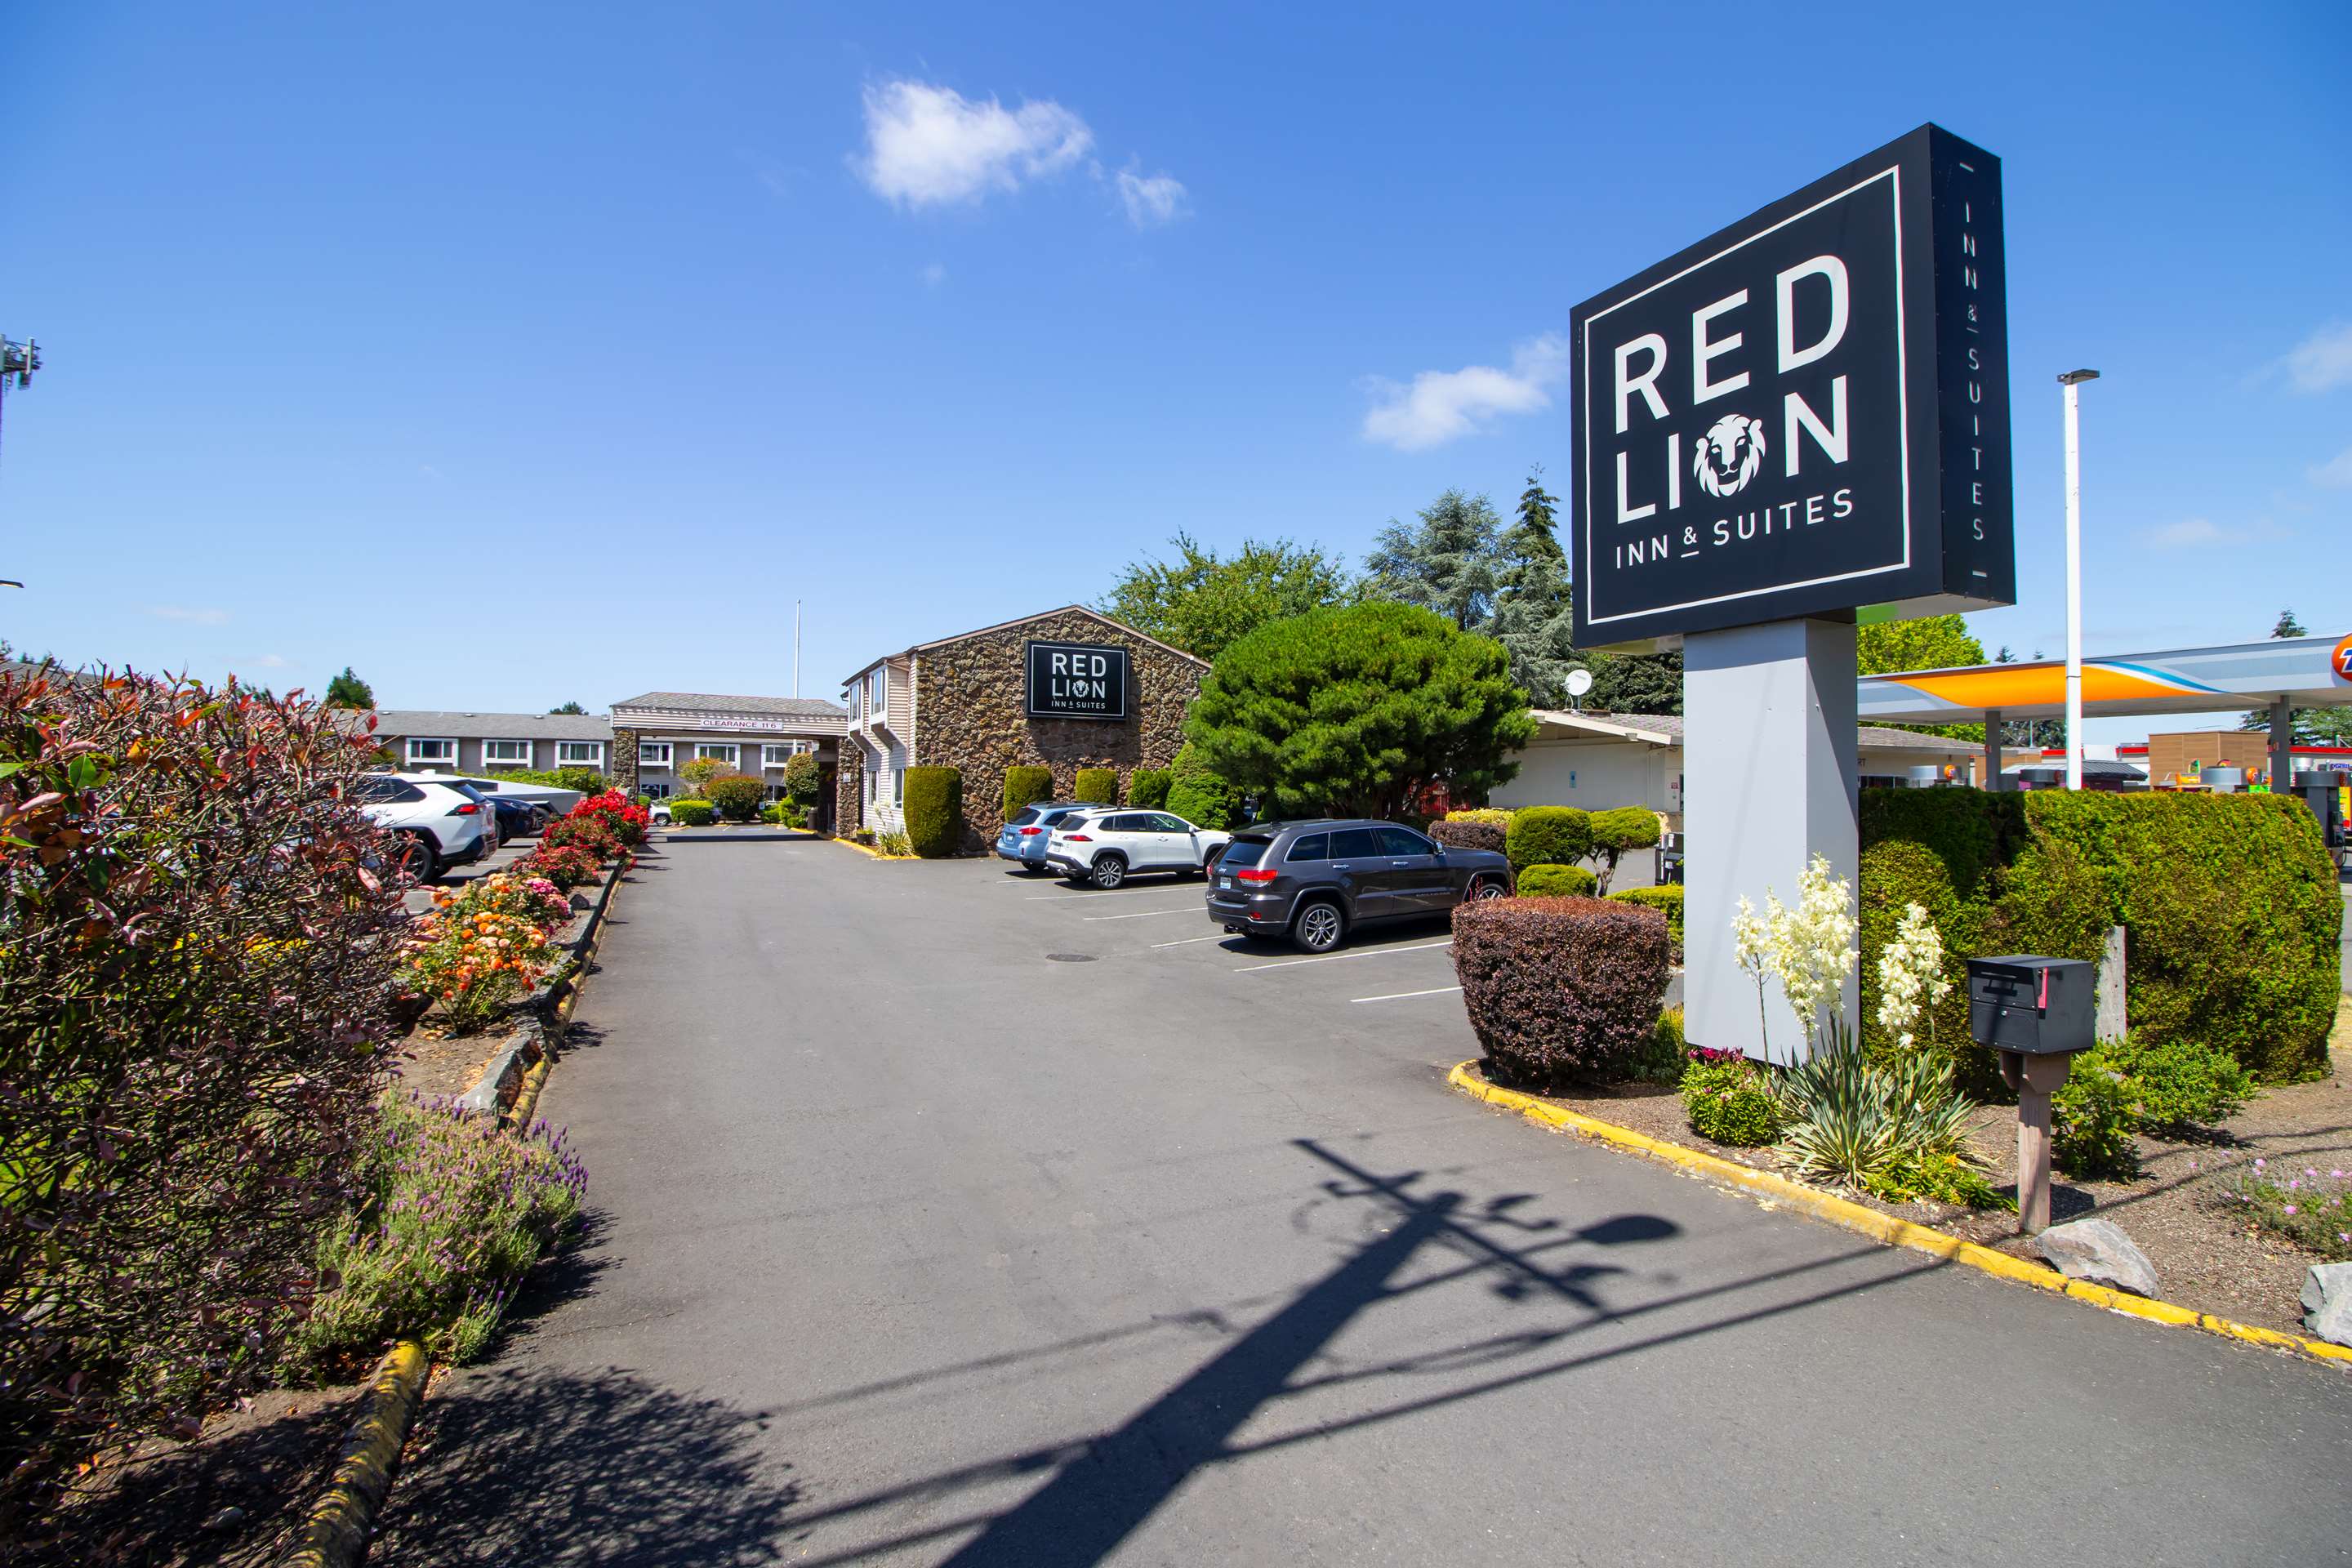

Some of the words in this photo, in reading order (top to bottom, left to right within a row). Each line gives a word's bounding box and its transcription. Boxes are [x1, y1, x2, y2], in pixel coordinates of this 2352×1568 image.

[1963, 201, 1977, 290] INN
[1615, 254, 1850, 435] RED
[1968, 347, 1984, 541] SUITES
[1616, 534, 1668, 569] INN
[1682, 525, 1699, 547] &
[1713, 488, 1853, 546] SUITES
[1051, 700, 1067, 708] INN
[1076, 702, 1106, 710] SUITES
[1052, 653, 1107, 677] RED
